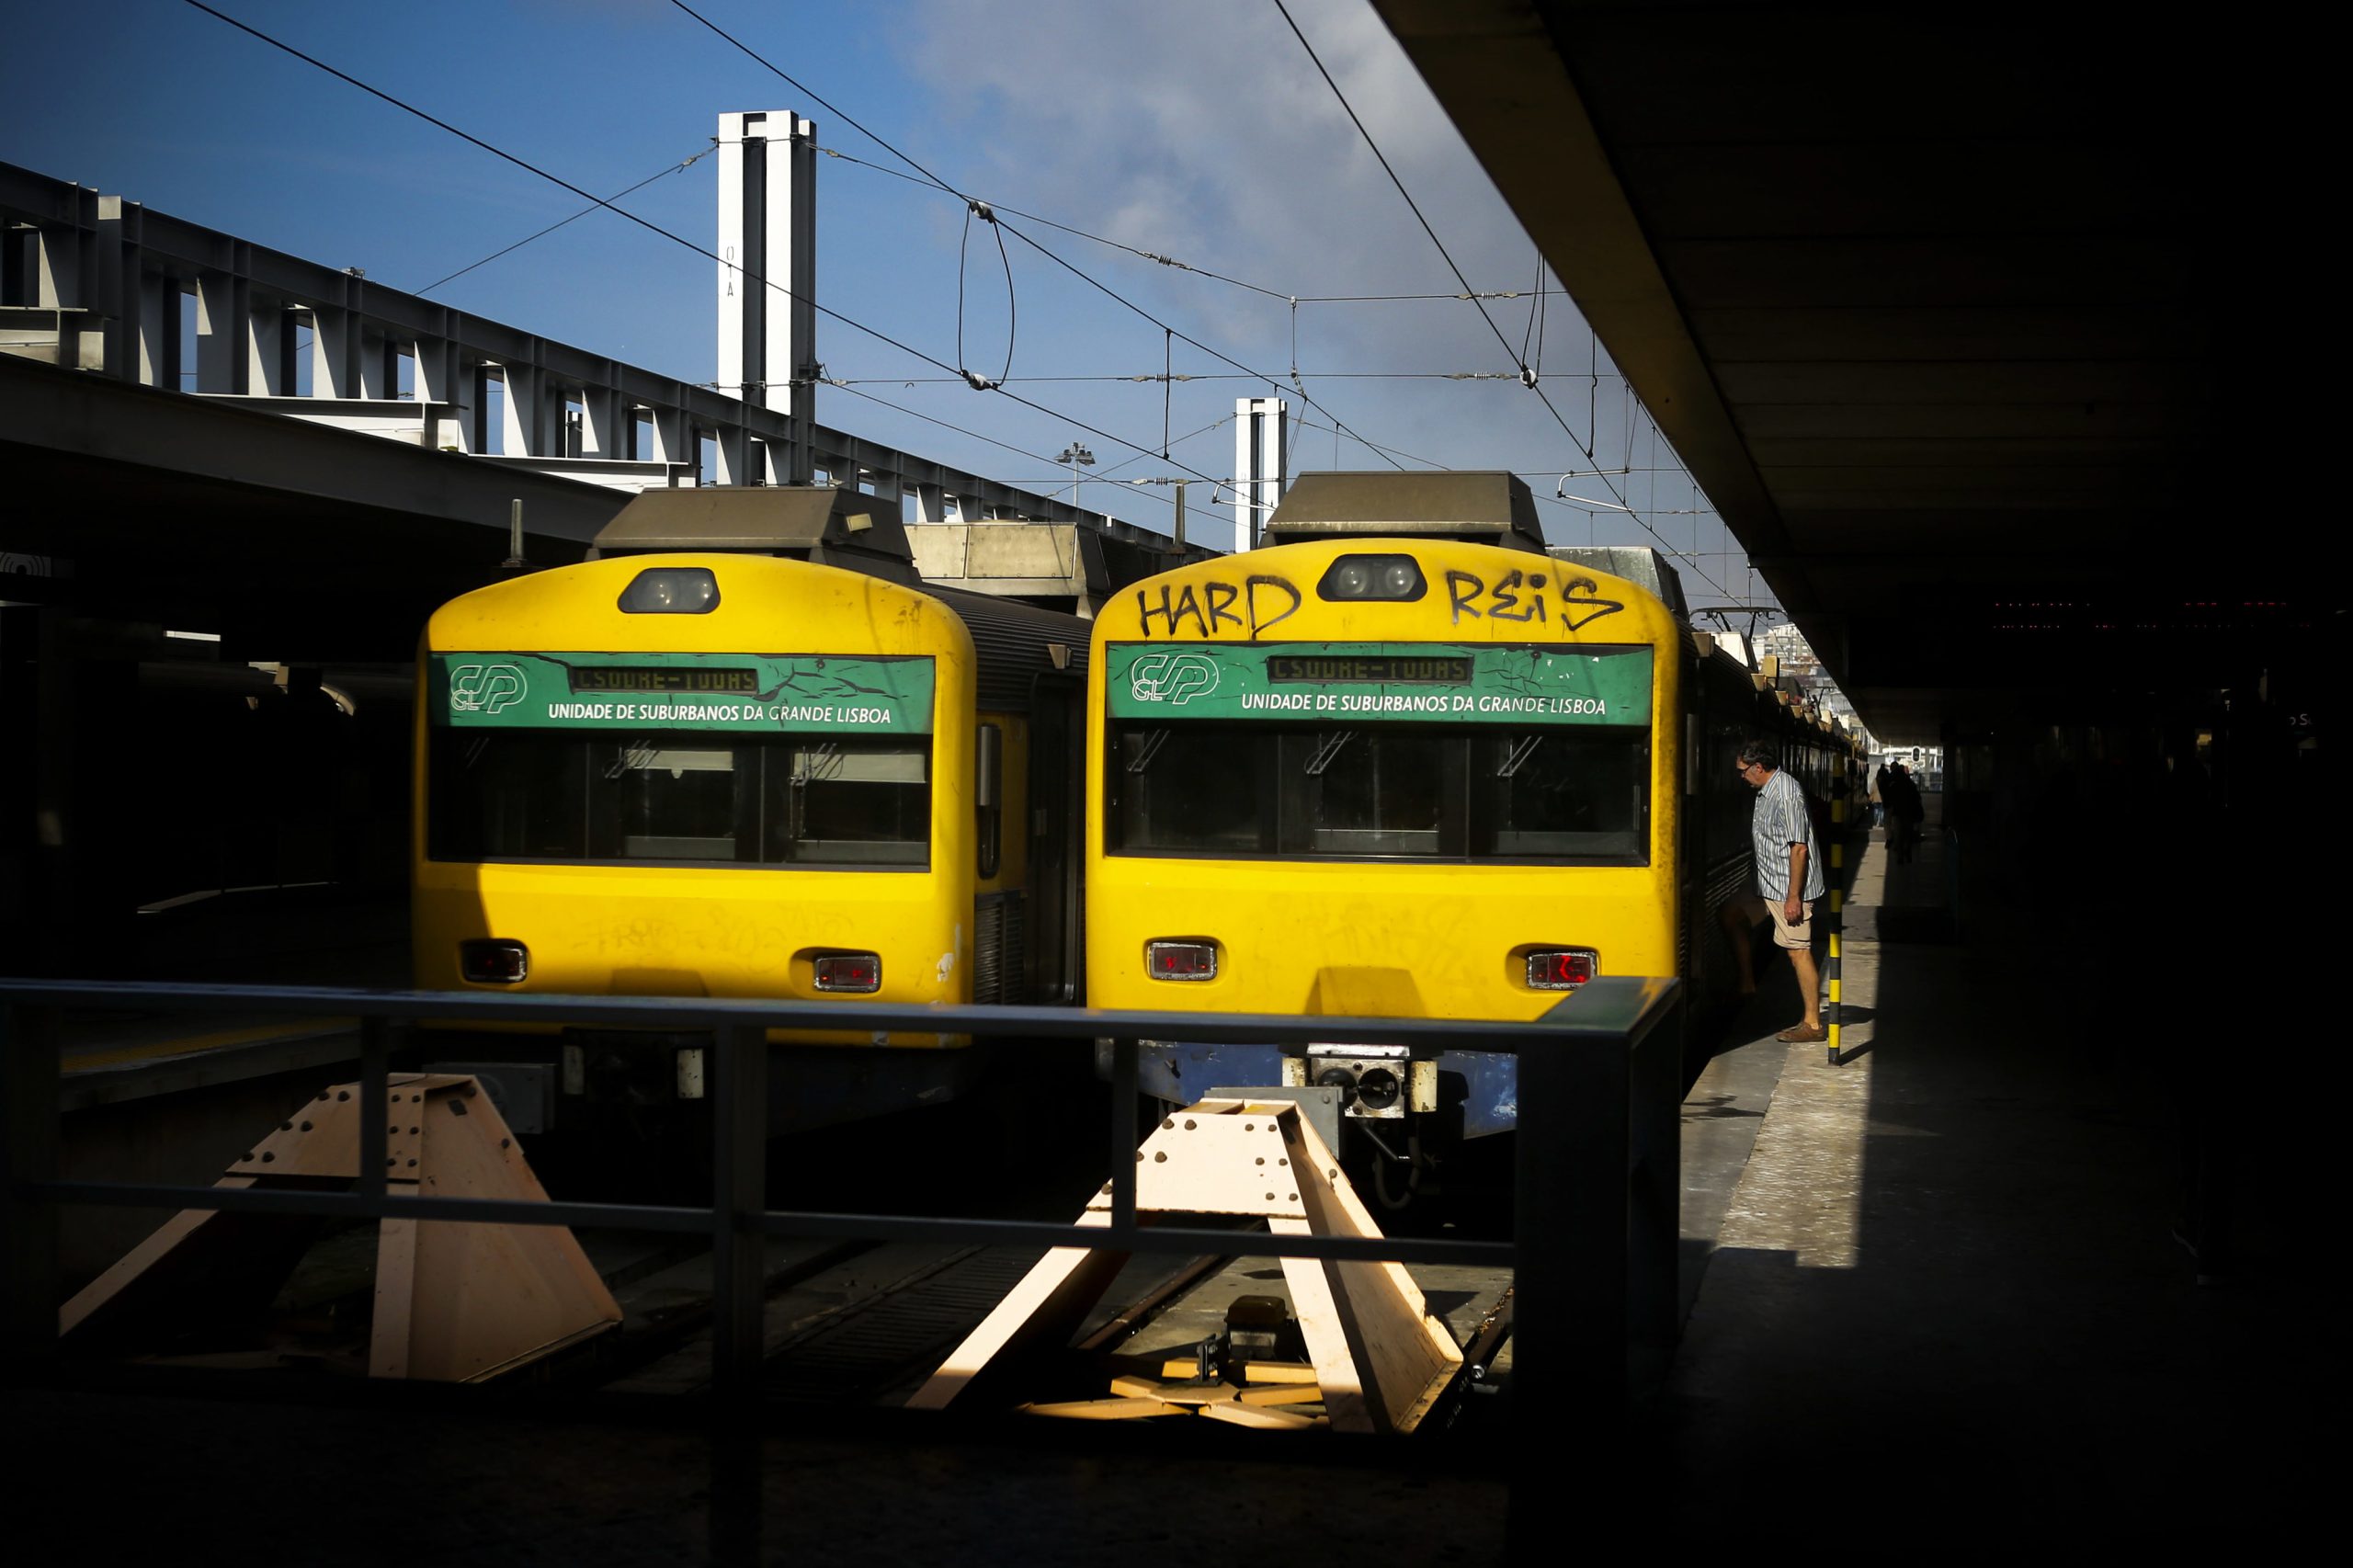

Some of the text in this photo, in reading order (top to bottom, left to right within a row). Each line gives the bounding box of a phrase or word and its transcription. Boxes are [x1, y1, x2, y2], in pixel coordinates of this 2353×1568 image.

[1137, 574, 1302, 642] HARD
[548, 703, 892, 723] UNIDADE DE SUBURBANOS DA GRANDE LISBOA
[1241, 693, 1607, 715] UNIDADE DE SUBURBANOS DA GRANDE LISBOA
